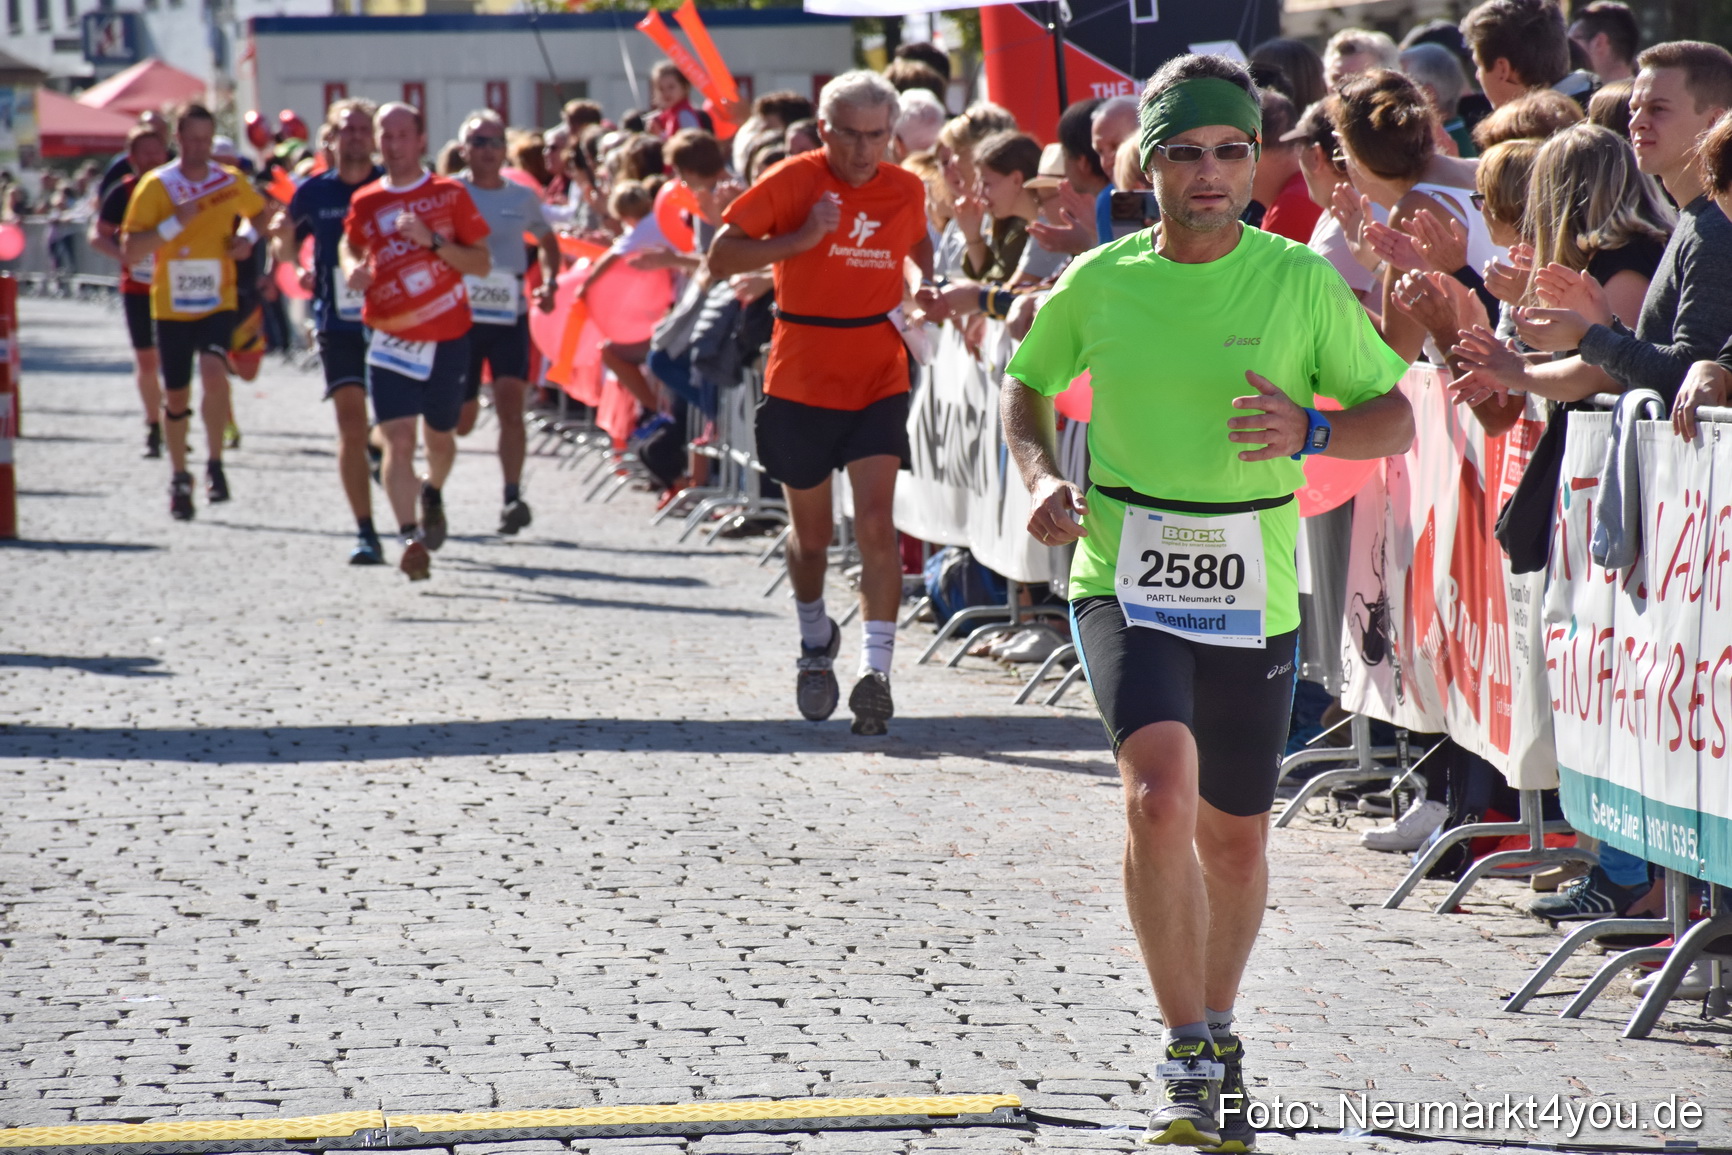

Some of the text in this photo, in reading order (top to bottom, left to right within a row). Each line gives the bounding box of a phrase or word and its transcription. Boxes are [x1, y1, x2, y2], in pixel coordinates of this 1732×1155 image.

[1090, 81, 1129, 98] THE
[471, 285, 511, 304] 2265
[1236, 337, 1261, 346] asics
[1162, 525, 1226, 543] BOCK
[1137, 549, 1245, 590] 2580
[1146, 594, 1222, 604] PARTL Neumarkt
[1155, 611, 1226, 631] Benhard
[1278, 660, 1293, 676] asics
